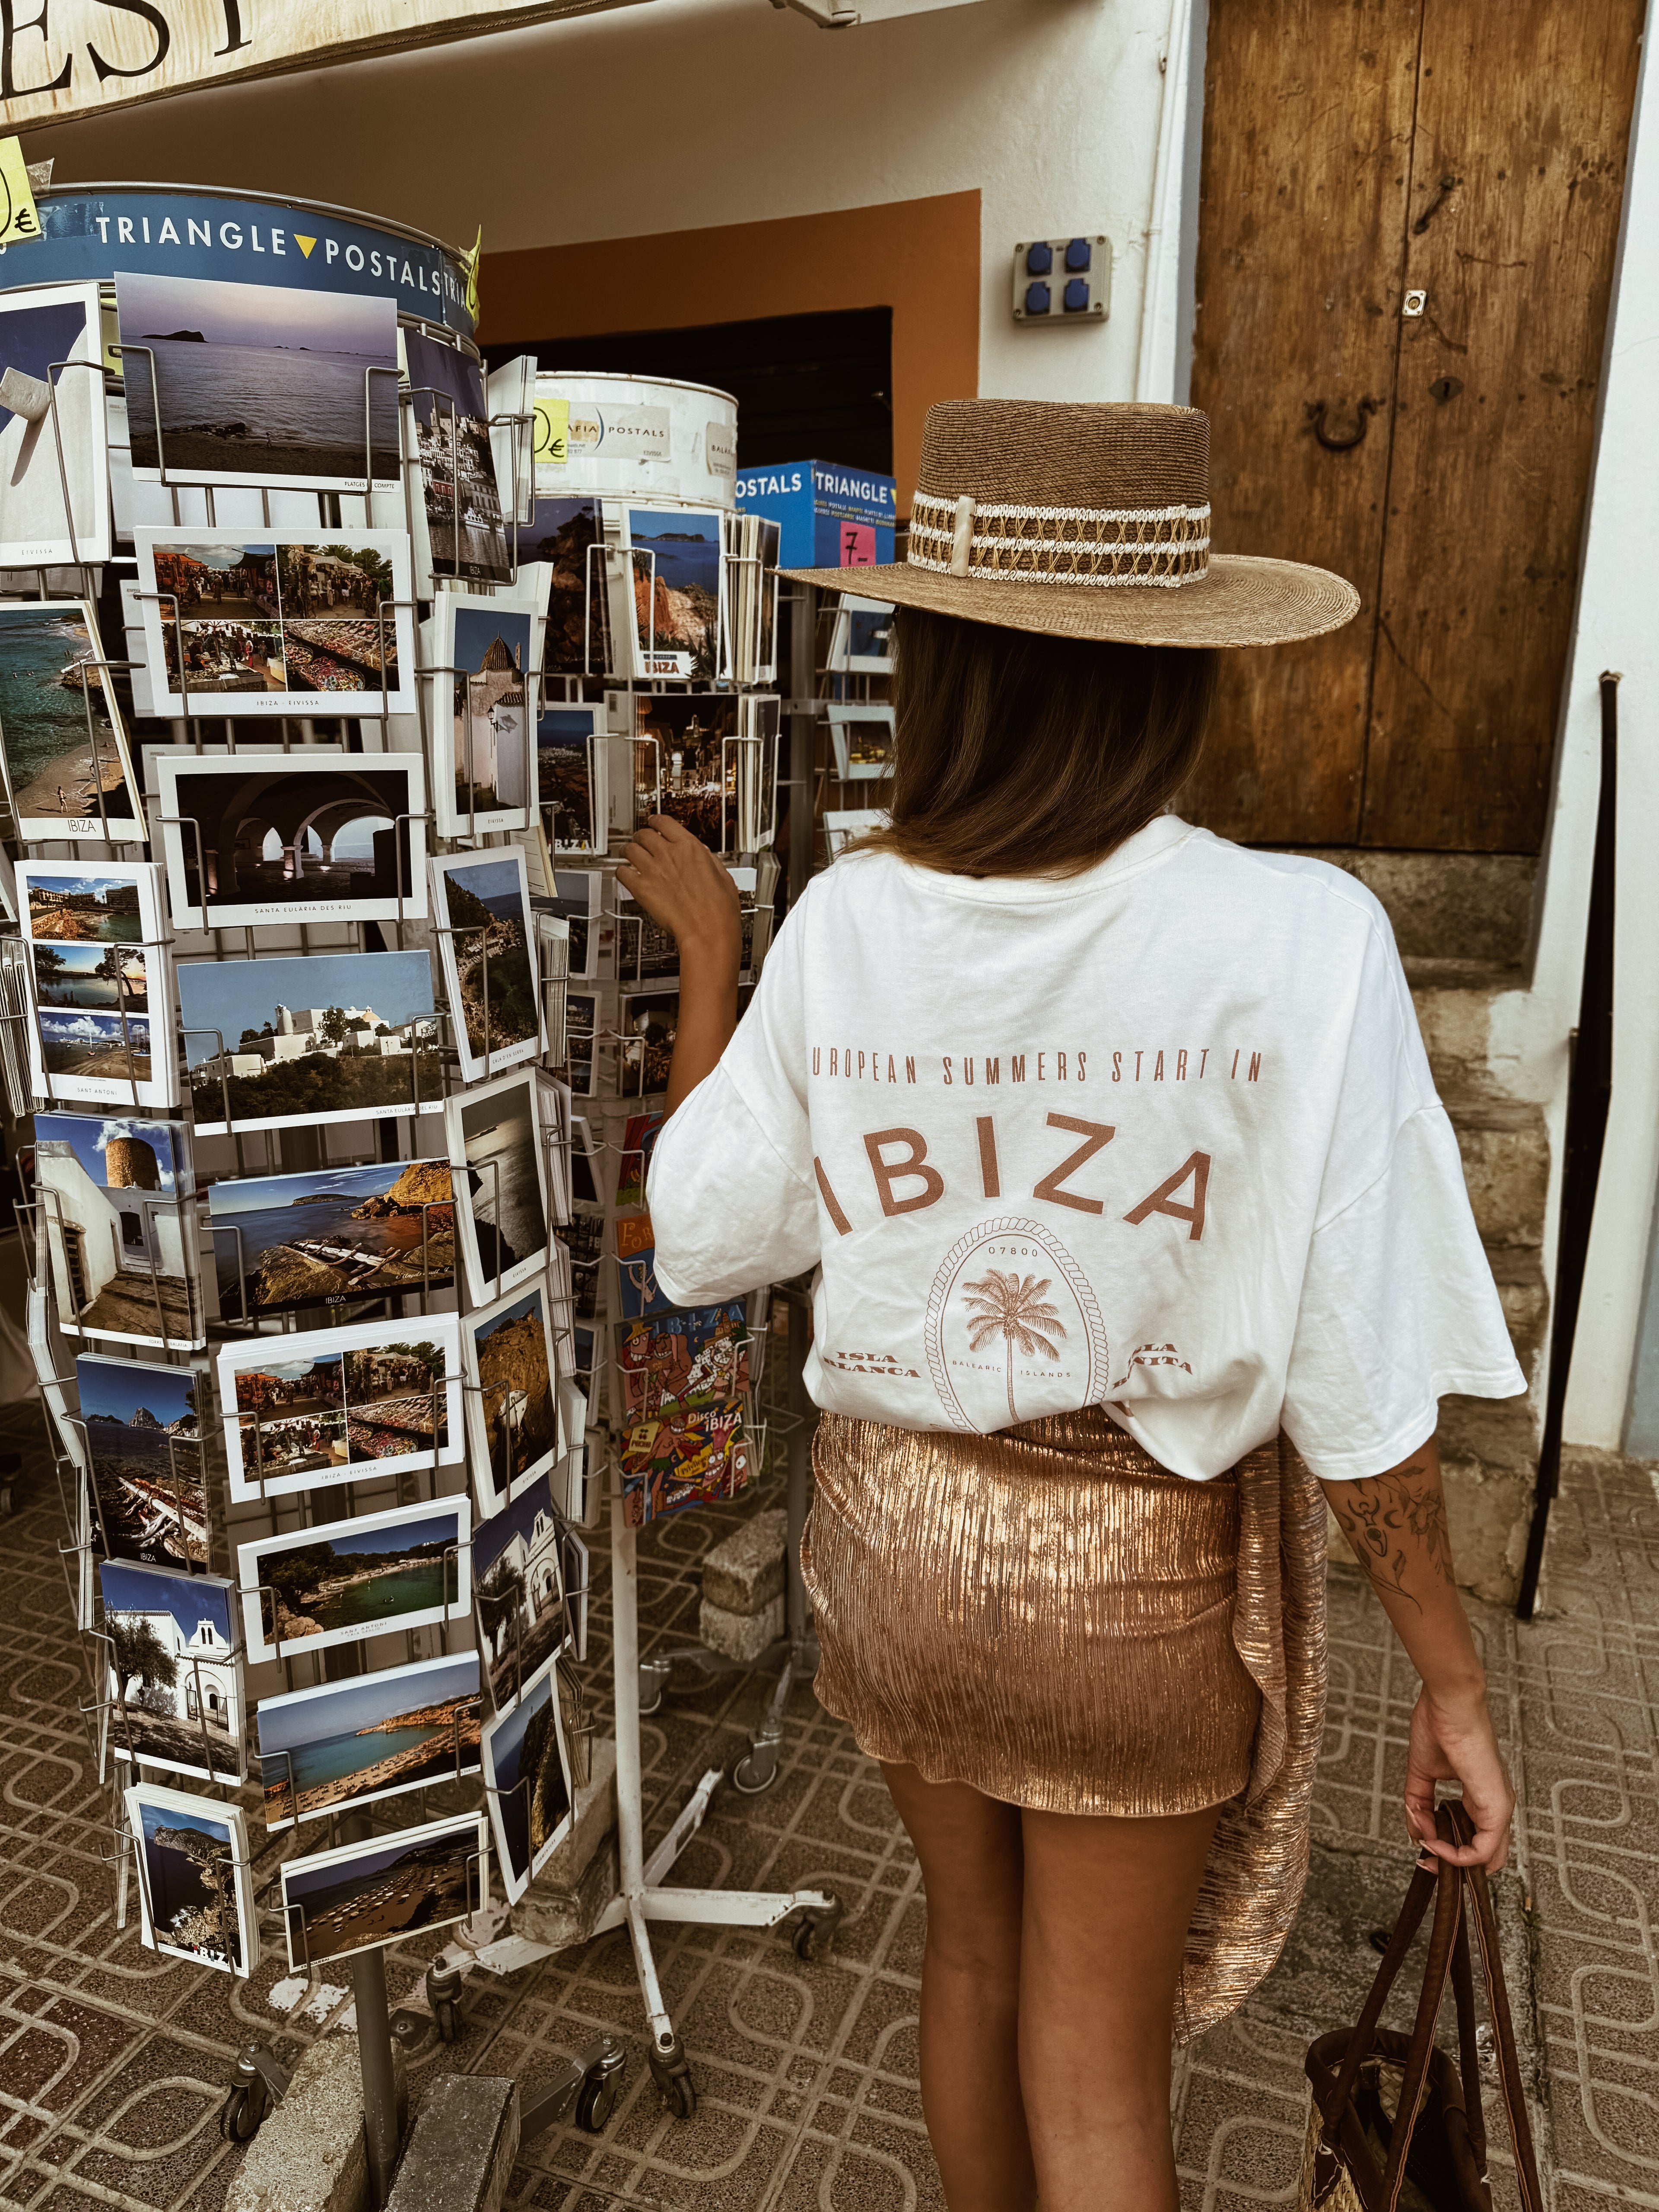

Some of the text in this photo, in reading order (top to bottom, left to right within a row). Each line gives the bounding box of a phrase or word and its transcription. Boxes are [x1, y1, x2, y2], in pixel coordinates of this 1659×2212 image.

[96, 216, 287, 256] TRIANGLE
[325, 238, 441, 296] POSTALS
[443, 271, 467, 312] TRIA
[567, 424, 664, 438] AFIA POSTALS
[735, 473, 802, 498] OSTALS
[815, 471, 888, 505] TRIANGLE
[68, 819, 96, 833] IBIZA
[813, 1047, 1261, 1085] UROPEAN SUMMERS START IN
[814, 1112, 1211, 1241] IBIZA
[621, 1222, 653, 1249] FOR
[988, 1246, 1037, 1257] 07800
[325, 1296, 346, 1304] IBIZA
[836, 1351, 899, 1363] ISLA
[952, 1360, 1001, 1373] BALEARIC
[350, 1466, 377, 1475] EIVISSA
[140, 1553, 156, 1563] IBIZA
[361, 1621, 387, 1630] ANTONI
